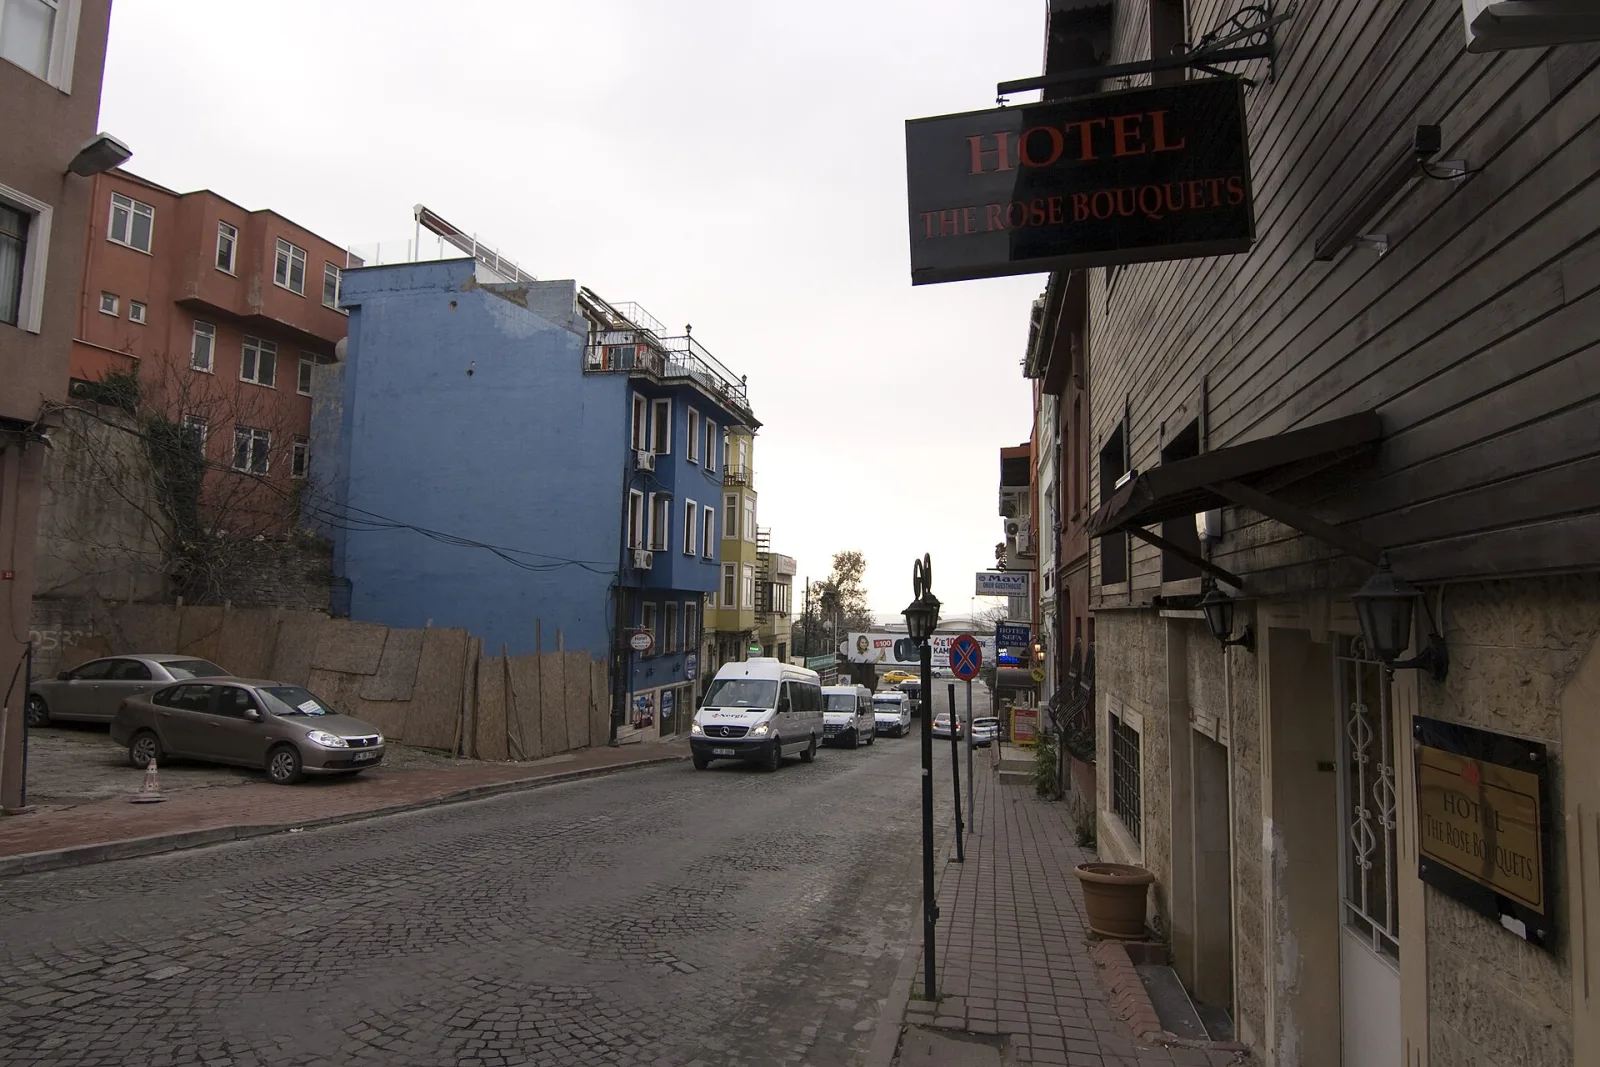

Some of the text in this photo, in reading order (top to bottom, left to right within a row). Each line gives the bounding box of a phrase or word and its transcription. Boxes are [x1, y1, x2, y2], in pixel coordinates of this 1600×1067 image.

[966, 110, 1186, 176] HOTEL
[919, 176, 1245, 239] THE ROSE BOUQUETS
[988, 575, 1026, 583] Mavi
[999, 627, 1026, 635] HOTEL
[1443, 791, 1505, 834] HOTEL
[1426, 813, 1533, 882] THE ROSE BOUQUETS
